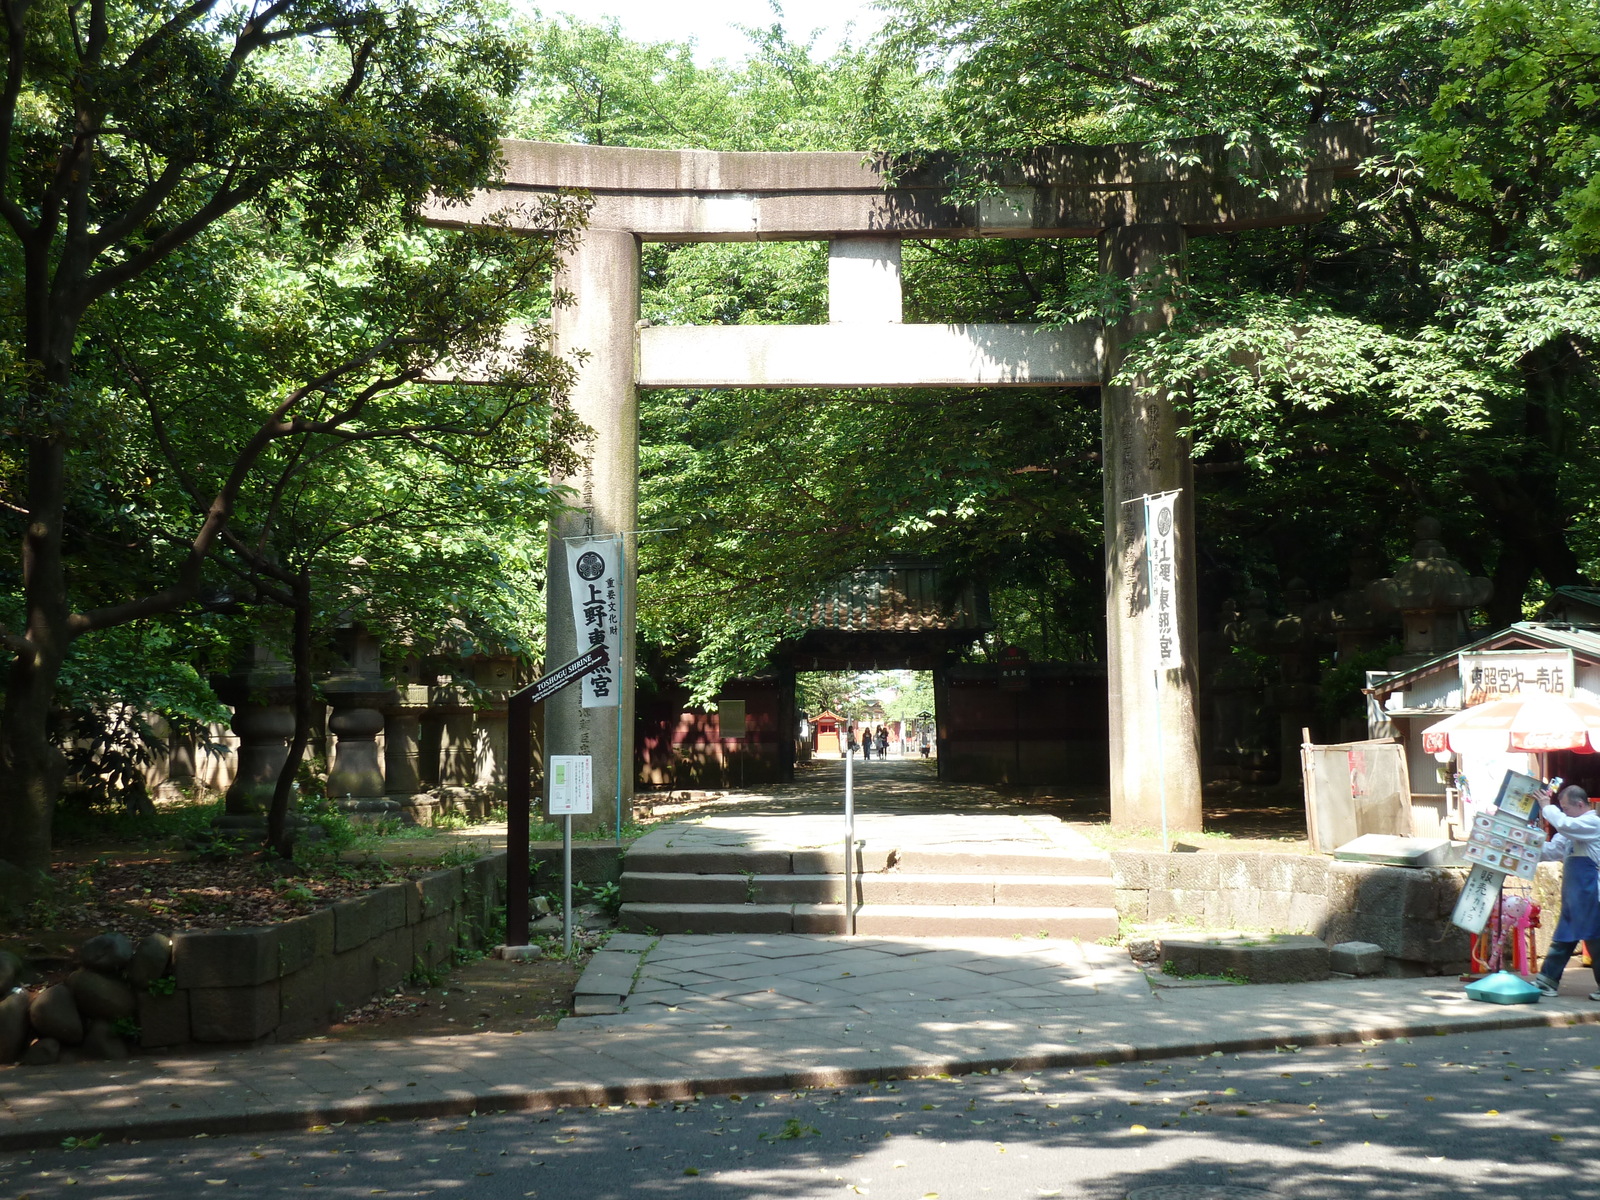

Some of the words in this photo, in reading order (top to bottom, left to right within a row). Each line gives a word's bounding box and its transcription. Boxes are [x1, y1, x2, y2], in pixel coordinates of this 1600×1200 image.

[605, 577, 618, 636] 重要文化財
[537, 669, 568, 691] TOSHOGU
[568, 654, 593, 674] SHRINE
